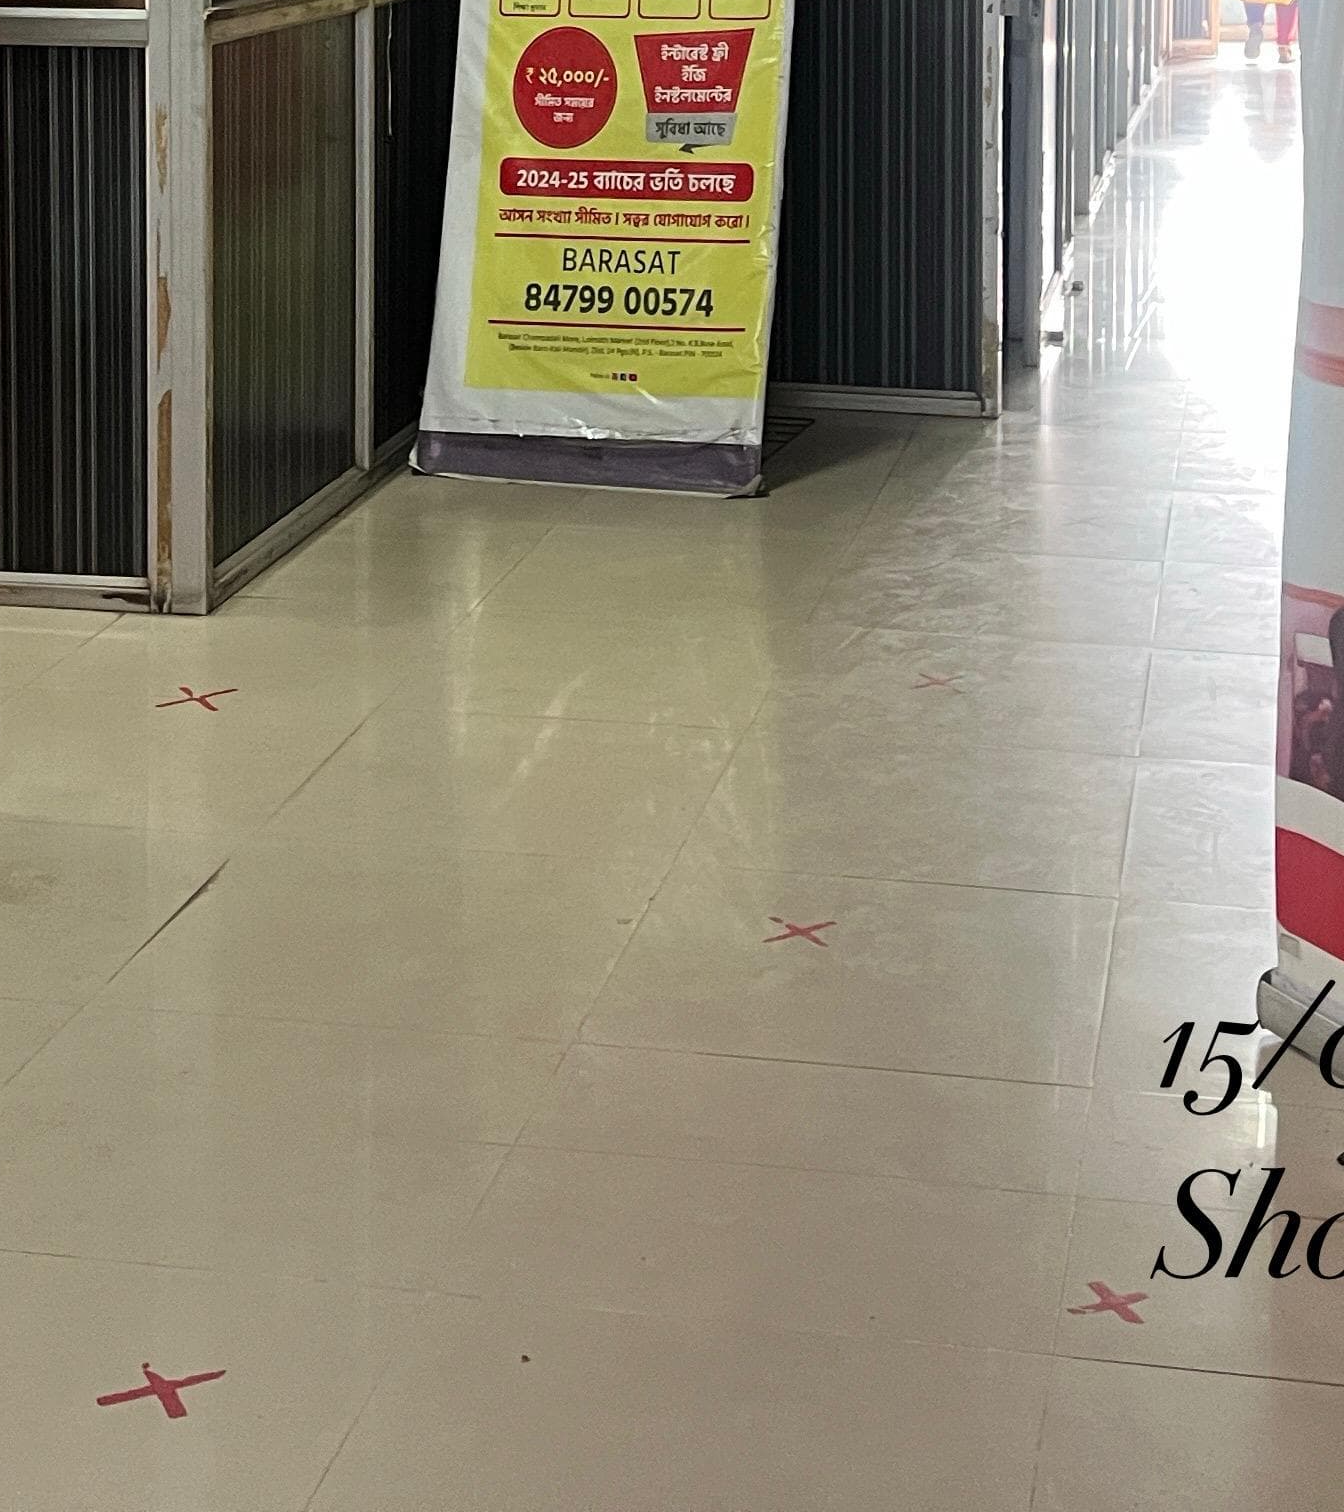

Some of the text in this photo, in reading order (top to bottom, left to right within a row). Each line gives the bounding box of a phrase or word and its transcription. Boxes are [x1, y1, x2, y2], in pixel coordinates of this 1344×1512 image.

[693, 122, 727, 137] আছে
[517, 169, 588, 189] 2024-25
[562, 247, 681, 275] BARASAT
[524, 282, 714, 317] 84799 00574
